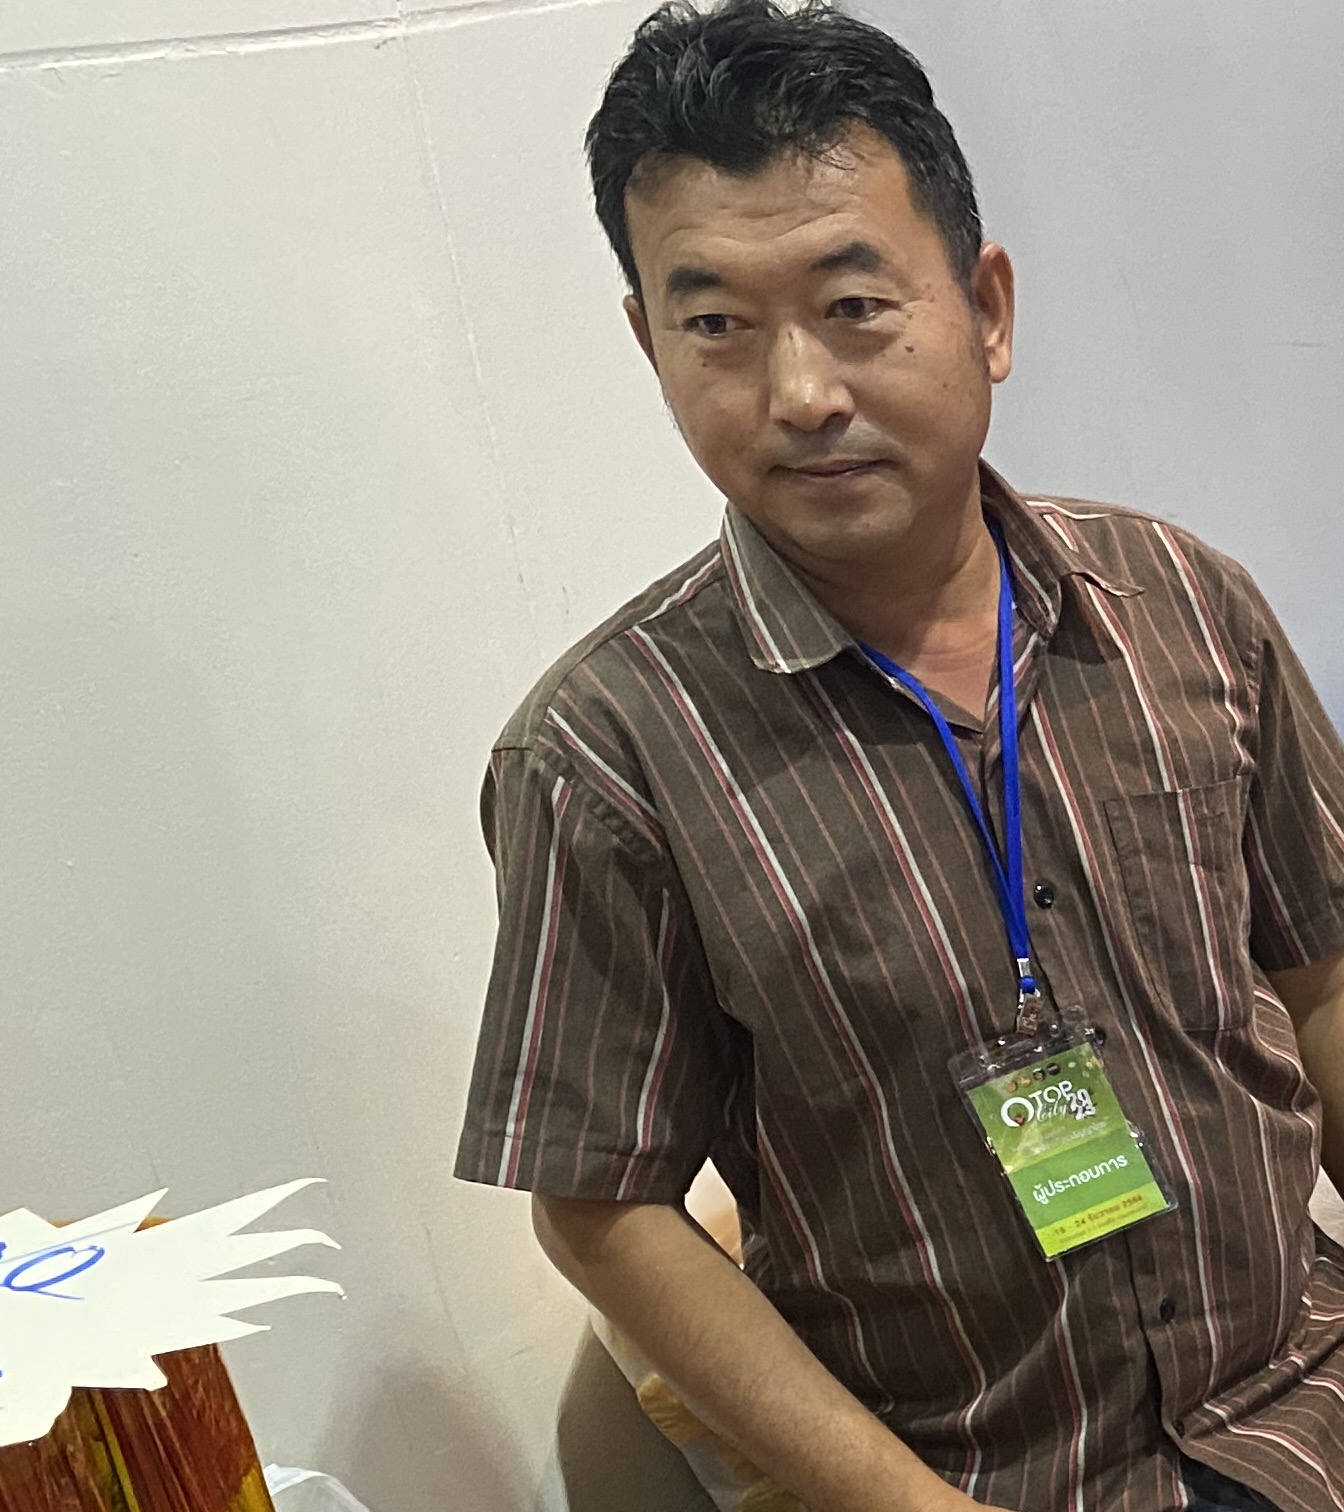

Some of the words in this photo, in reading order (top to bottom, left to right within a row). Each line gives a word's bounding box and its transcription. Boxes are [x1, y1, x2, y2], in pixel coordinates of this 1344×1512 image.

[1032, 1154, 1128, 1204] ผู้ประกอบการ
